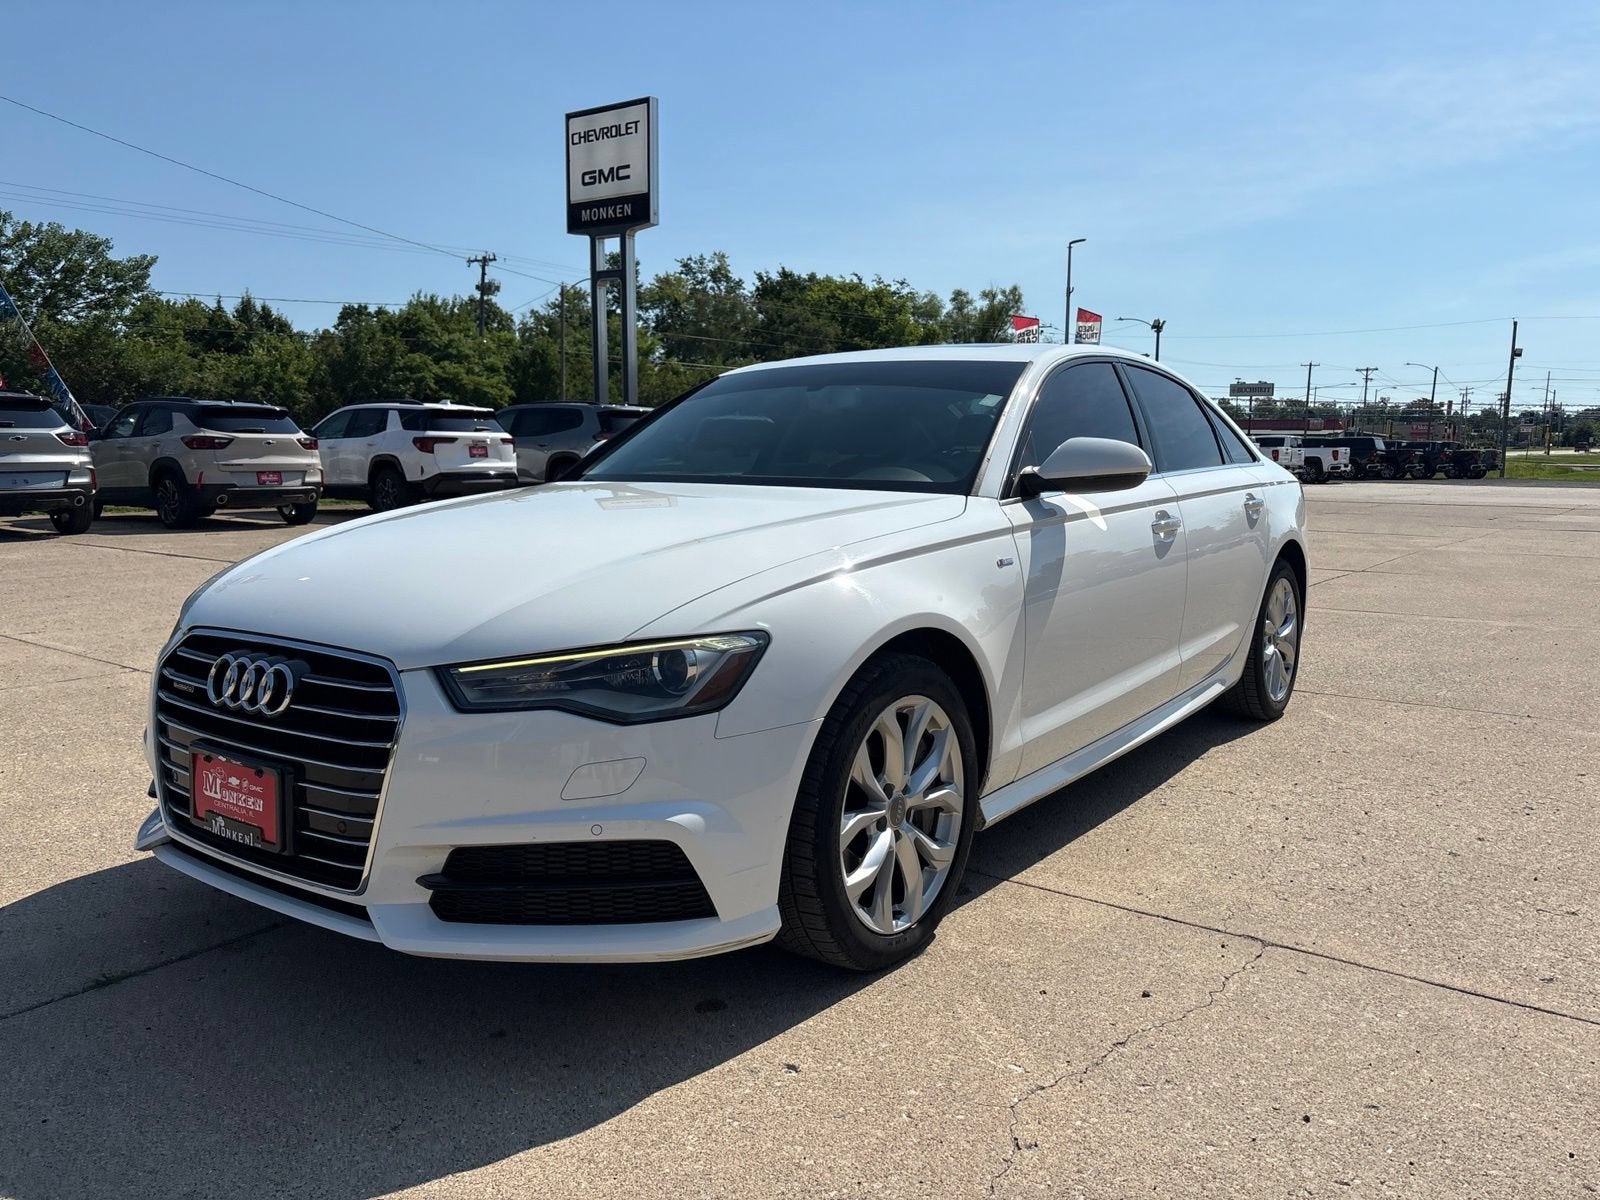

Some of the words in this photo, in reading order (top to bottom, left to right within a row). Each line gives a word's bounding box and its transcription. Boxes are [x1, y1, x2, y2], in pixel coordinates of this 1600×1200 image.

[571, 120, 640, 146] CHEVROLET
[581, 164, 631, 186] GMC
[581, 203, 632, 222] MONKEN
[203, 771, 263, 811] MONKEN
